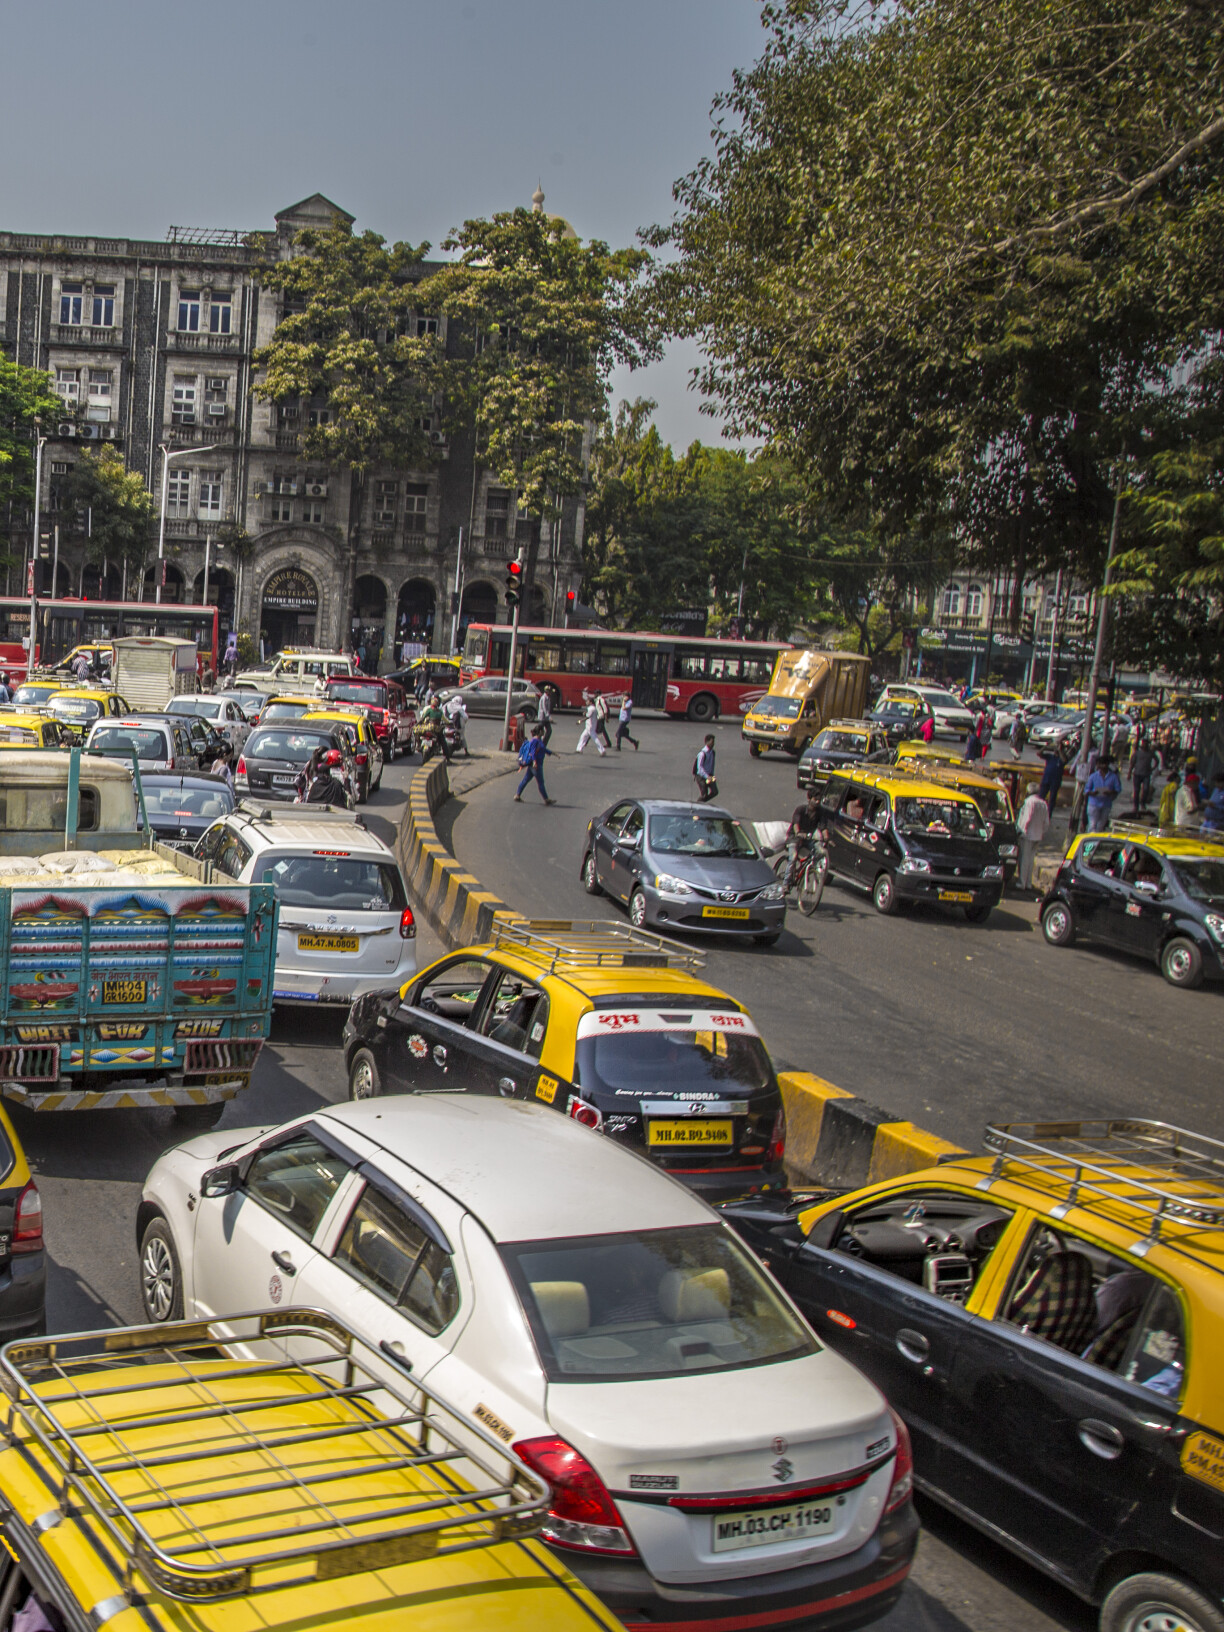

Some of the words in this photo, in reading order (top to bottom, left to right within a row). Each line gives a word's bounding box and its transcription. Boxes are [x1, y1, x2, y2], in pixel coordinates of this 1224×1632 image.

[263, 596, 287, 604] EMPIRE
[287, 597, 317, 605] BUILDING
[299, 938, 356, 949] MH.47.N.0805
[598, 1014, 639, 1029] शुभ
[710, 1014, 745, 1027] लाभ
[18, 1025, 72, 1041] WAIT
[99, 1023, 145, 1039] FOR
[177, 1019, 223, 1037] SIDE
[679, 1092, 714, 1101] BINDRA
